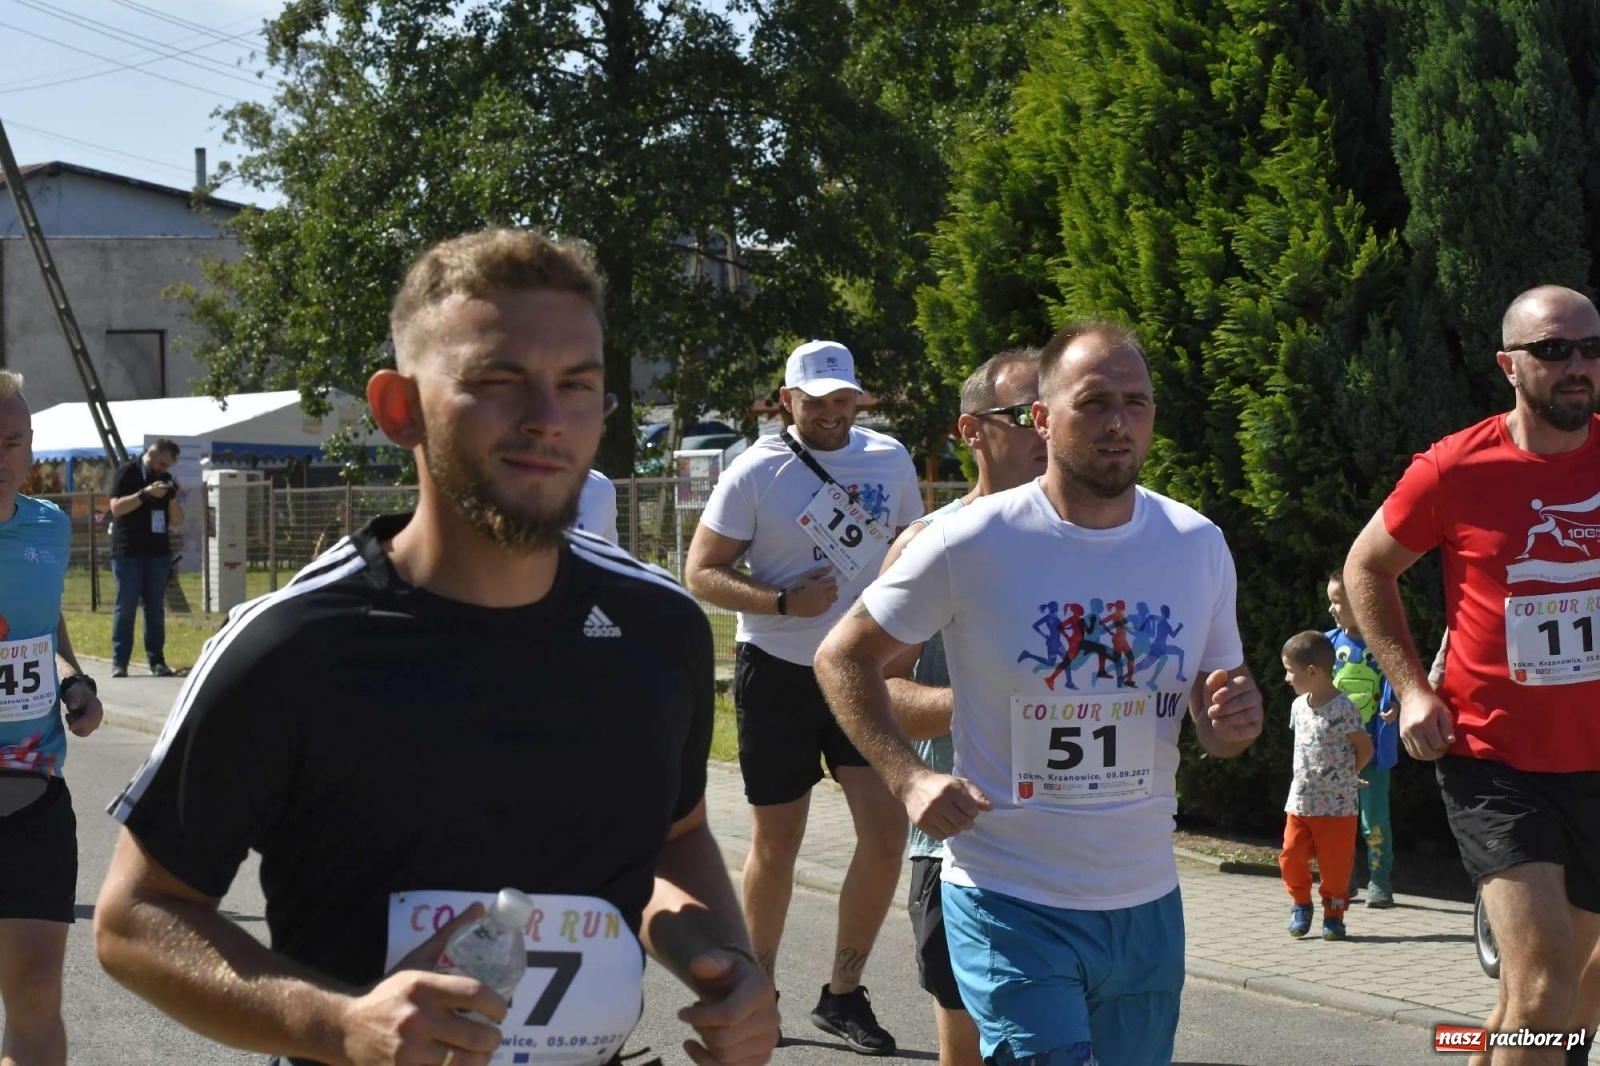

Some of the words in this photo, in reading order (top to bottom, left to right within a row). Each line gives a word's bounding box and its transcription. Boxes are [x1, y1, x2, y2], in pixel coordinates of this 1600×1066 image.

[827, 507, 863, 548] 19
[1514, 599, 1579, 617] COLOUR
[583, 626, 622, 637] adidas
[1537, 616, 1593, 655] 11
[32, 640, 49, 656] RUN
[0, 660, 41, 696] 45
[1022, 703, 1102, 722] COLOUR
[1110, 700, 1147, 721] RUN
[1156, 691, 1183, 718] UN
[1047, 724, 1117, 770] 51
[1017, 772, 1046, 782] 10km,
[1048, 773, 1102, 782] Krzanowice,
[1106, 768, 1151, 780] 05.09.2021
[559, 908, 621, 943] RUN
